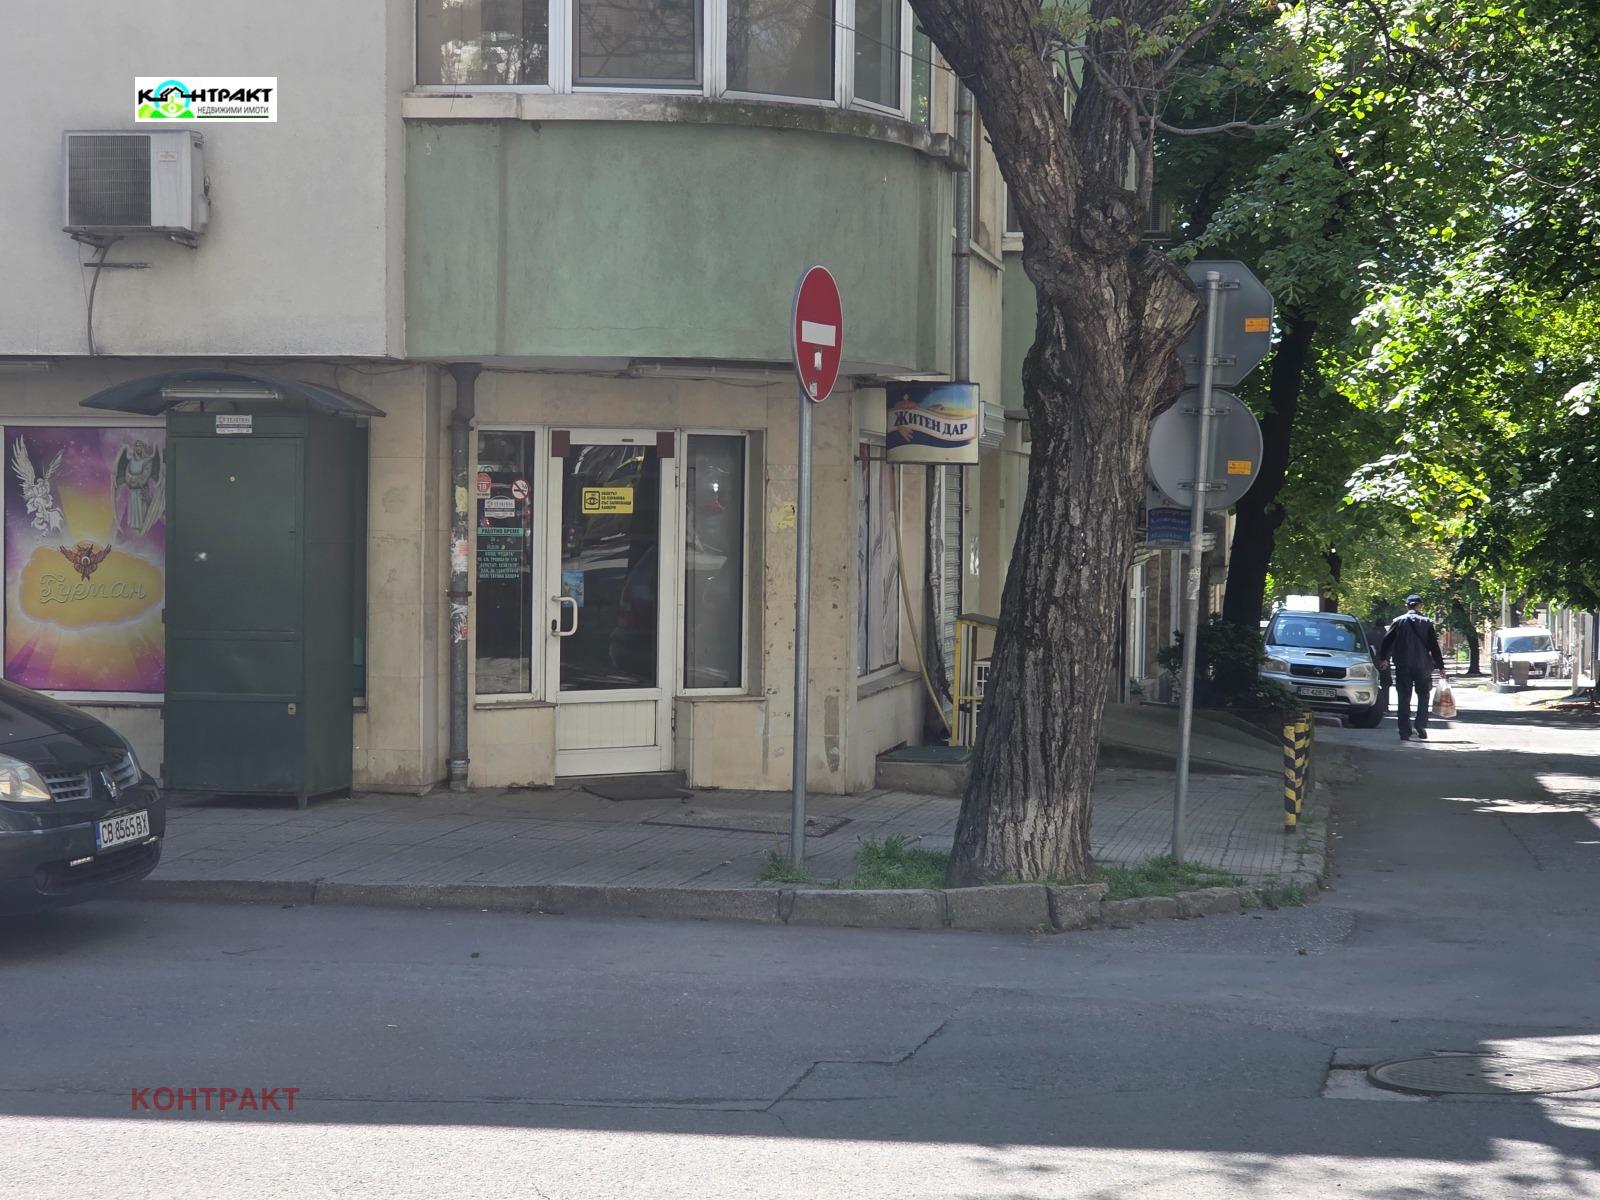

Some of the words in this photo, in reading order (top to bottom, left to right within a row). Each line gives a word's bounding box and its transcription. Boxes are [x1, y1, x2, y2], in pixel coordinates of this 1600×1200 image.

[894, 410, 941, 433] ЖИТЕН
[942, 423, 968, 437] ДАР
[40, 574, 146, 604] Гурман
[102, 823, 113, 844] CB
[115, 816, 135, 840] 8565
